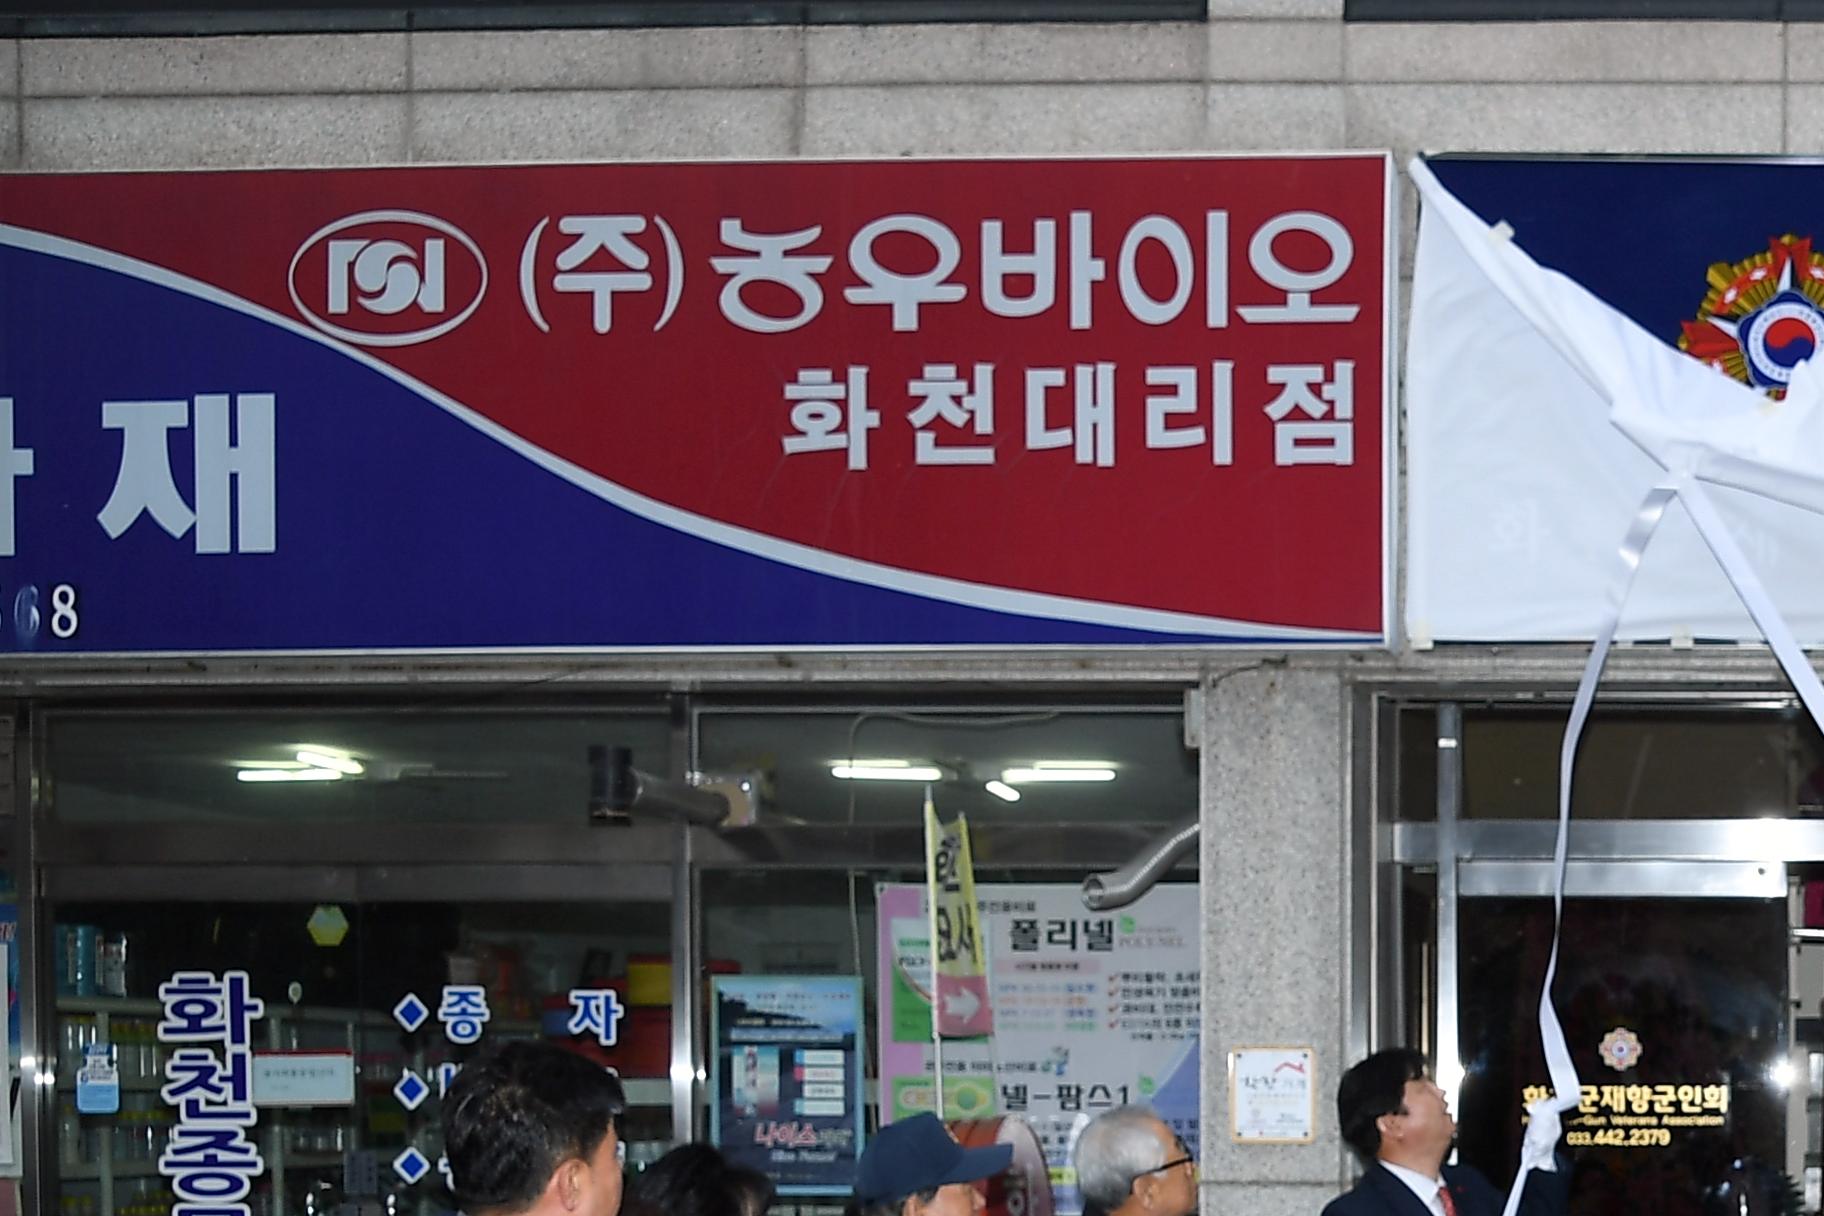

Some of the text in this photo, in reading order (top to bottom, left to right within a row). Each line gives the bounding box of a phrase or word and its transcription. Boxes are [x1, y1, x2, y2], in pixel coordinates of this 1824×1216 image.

[782, 360, 1356, 471] 화천대리점
[1522, 1084, 1729, 1114] 화군재향군인회
[1609, 1115, 1659, 1126] Veterans
[1661, 1115, 1725, 1126] Association
